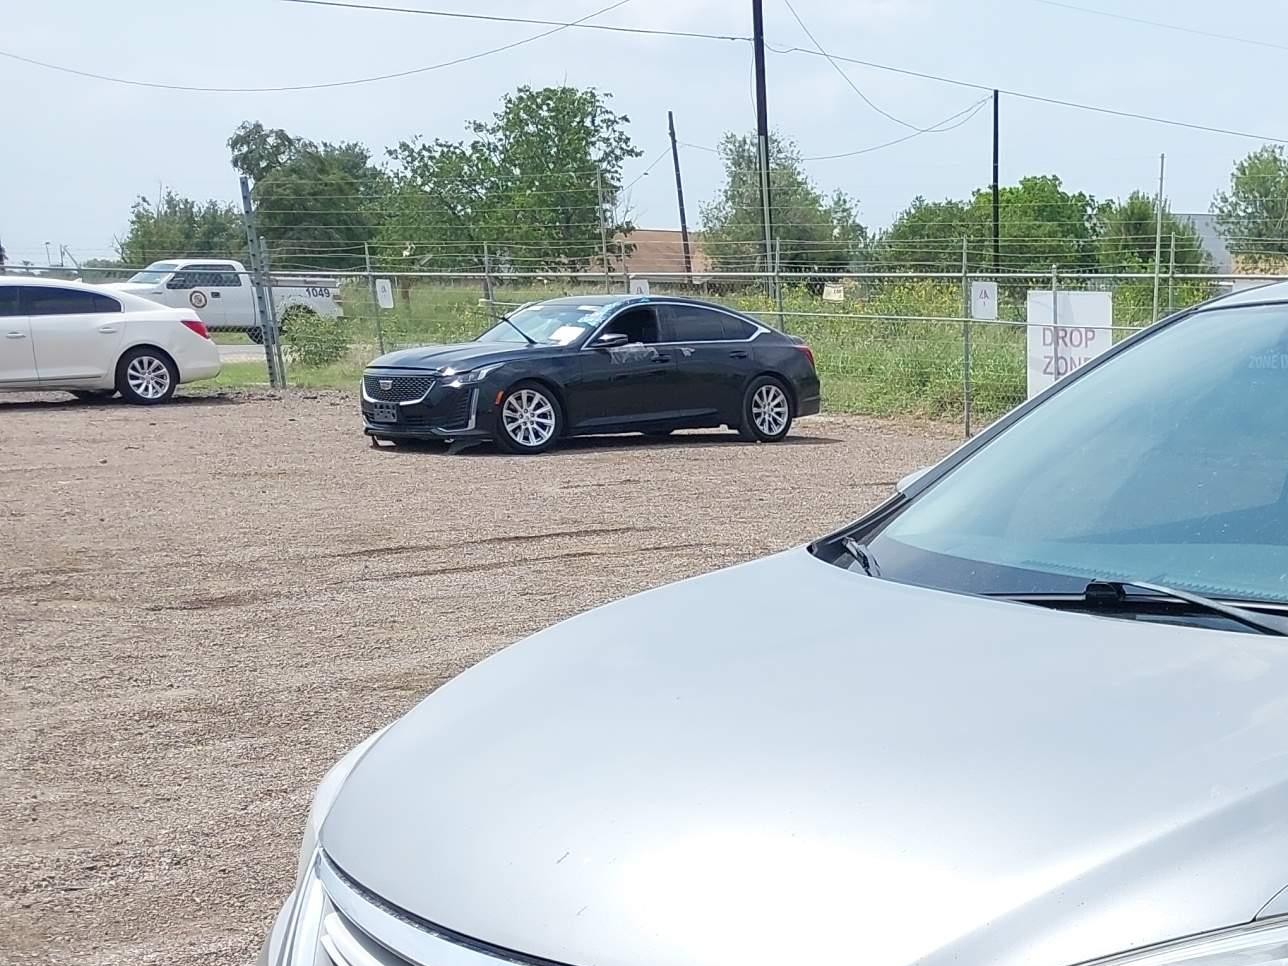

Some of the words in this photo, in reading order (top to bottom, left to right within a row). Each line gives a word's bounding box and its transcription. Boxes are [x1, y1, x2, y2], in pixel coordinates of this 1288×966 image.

[305, 287, 331, 298] 1049
[1042, 327, 1096, 348] DROP
[1042, 355, 1092, 376] ZON
